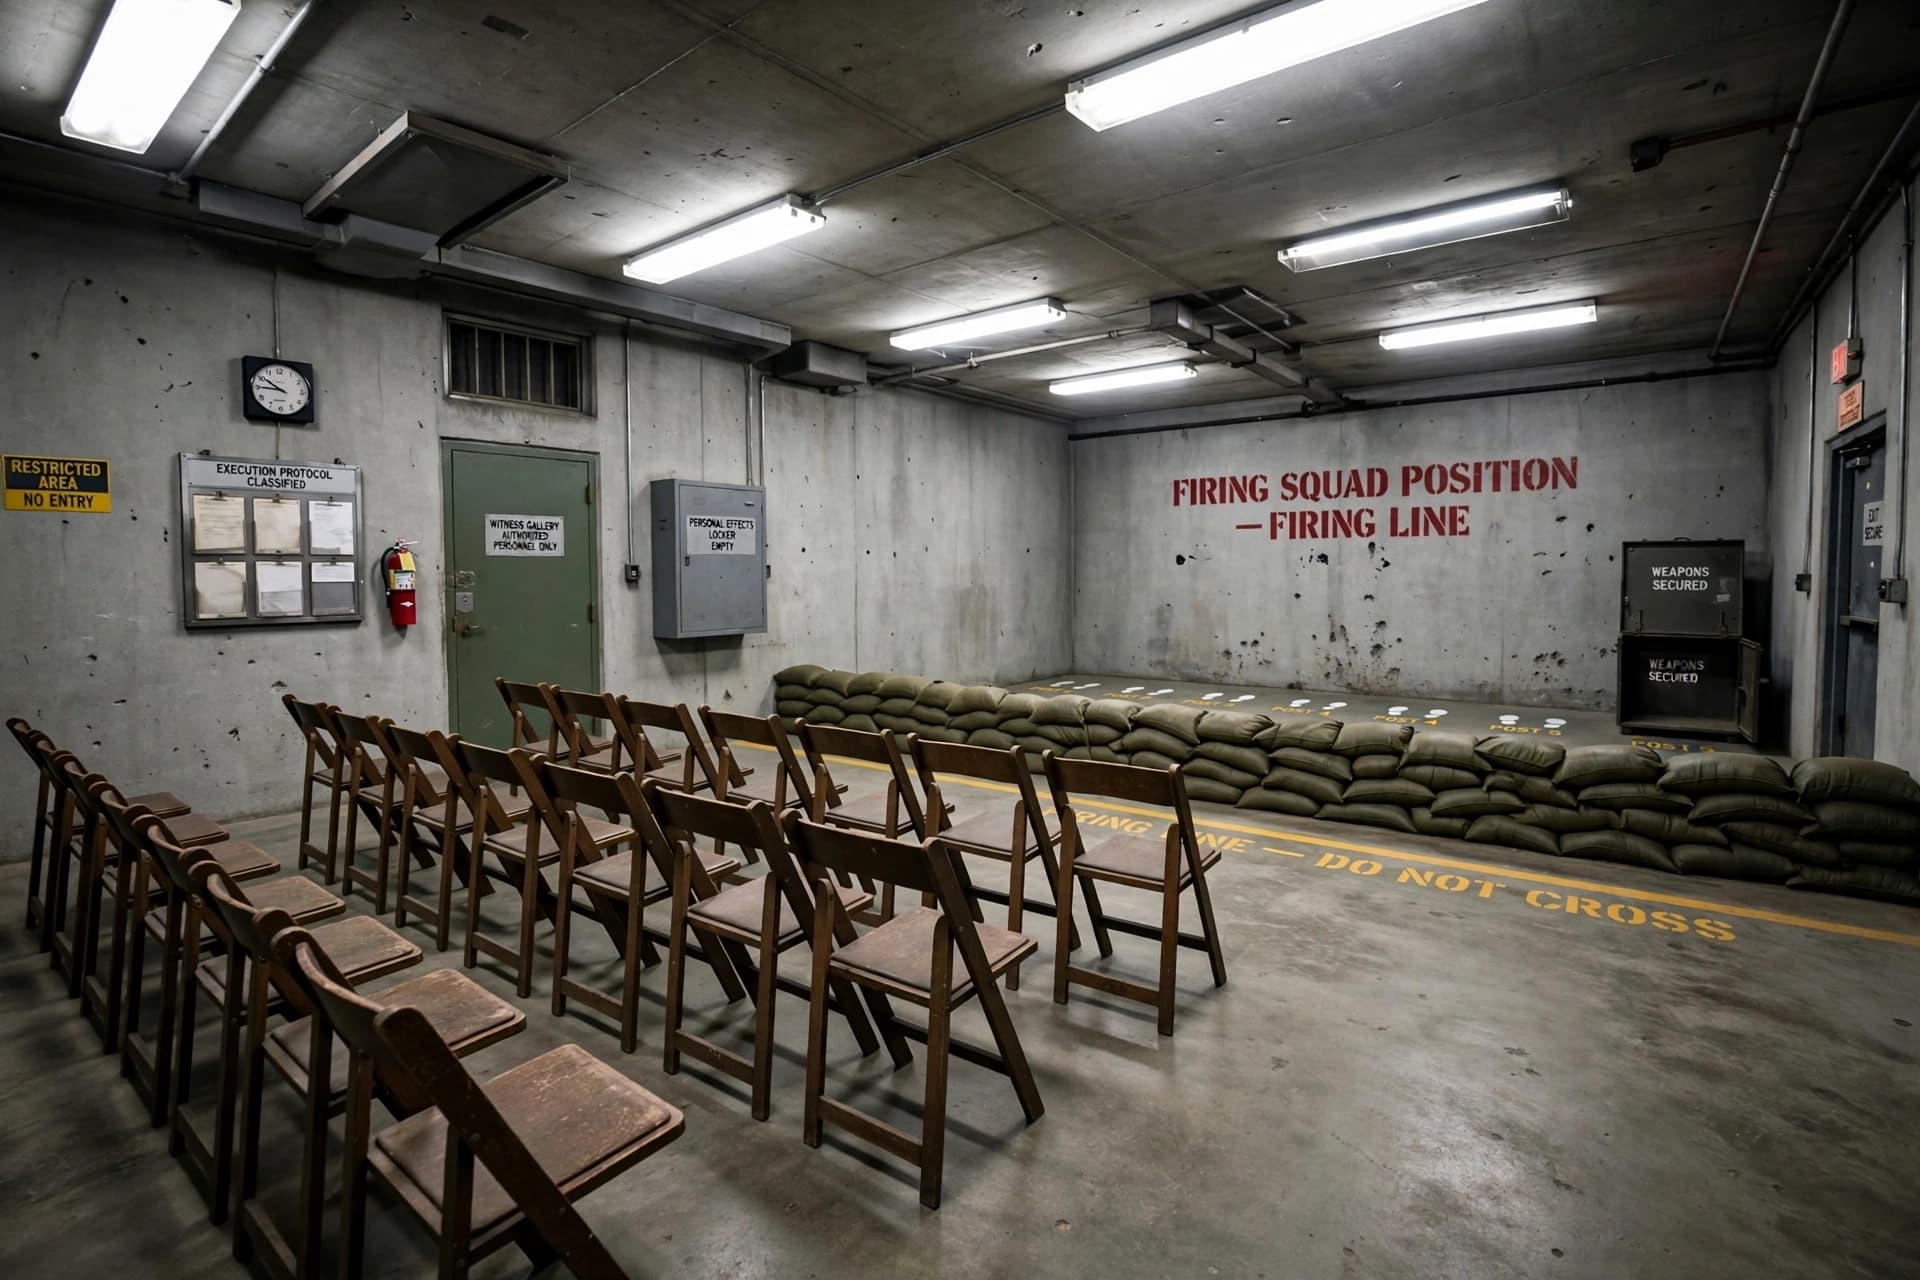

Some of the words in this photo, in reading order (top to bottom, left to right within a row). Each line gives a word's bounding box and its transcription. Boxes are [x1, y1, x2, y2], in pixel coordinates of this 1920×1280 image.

[11, 459, 101, 477] RESTRICTED
[216, 463, 276, 477] EXECUTION
[279, 466, 333, 480] PROTOCOL
[38, 475, 79, 490] AREA
[247, 476, 306, 489] CLASSIFIED
[1172, 474, 1269, 507] FIRING
[1280, 467, 1389, 502] SQUAD
[1401, 455, 1578, 497] POSITION
[23, 492, 44, 507] NO
[49, 493, 94, 509] ENTRY
[490, 519, 524, 530] WITNESS
[689, 518, 725, 528] PERSONAL
[726, 519, 754, 530] EFFECTS
[1389, 504, 1471, 537] LINE
[1651, 566, 1710, 577] WEAPONS
[1652, 579, 1708, 591] SECURED
[1648, 658, 1705, 671] WEAPONS
[1372, 714, 1420, 724] POST
[1489, 724, 1543, 734] POST
[1315, 852, 1383, 877] DO
[1396, 866, 1507, 899] NOT
[1525, 890, 1737, 942] CROSS
